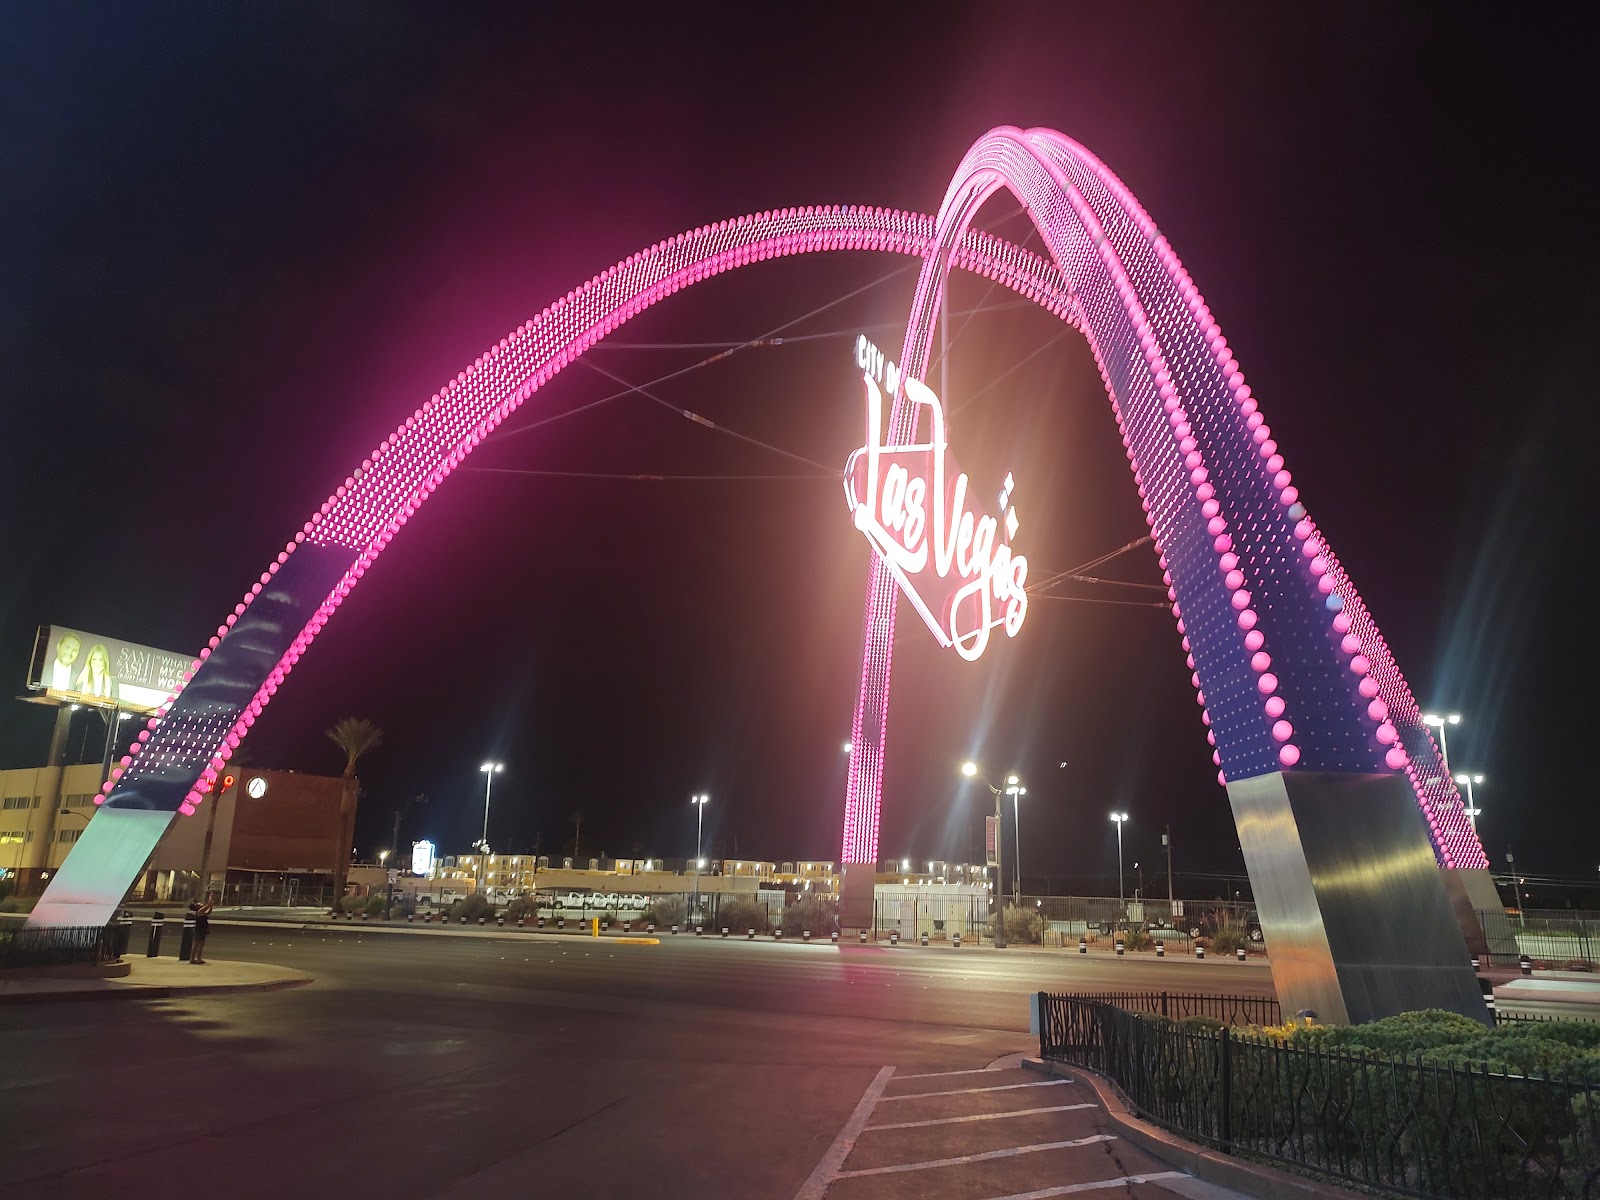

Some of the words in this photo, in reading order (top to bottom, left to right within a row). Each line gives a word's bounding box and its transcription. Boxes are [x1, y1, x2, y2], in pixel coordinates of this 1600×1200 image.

[857, 333, 885, 384] CITY
[854, 371, 928, 574] Las
[904, 376, 1029, 662] Vegas
[120, 647, 151, 665] SAM
[119, 660, 149, 677] ASH
[160, 665, 175, 678] MY
